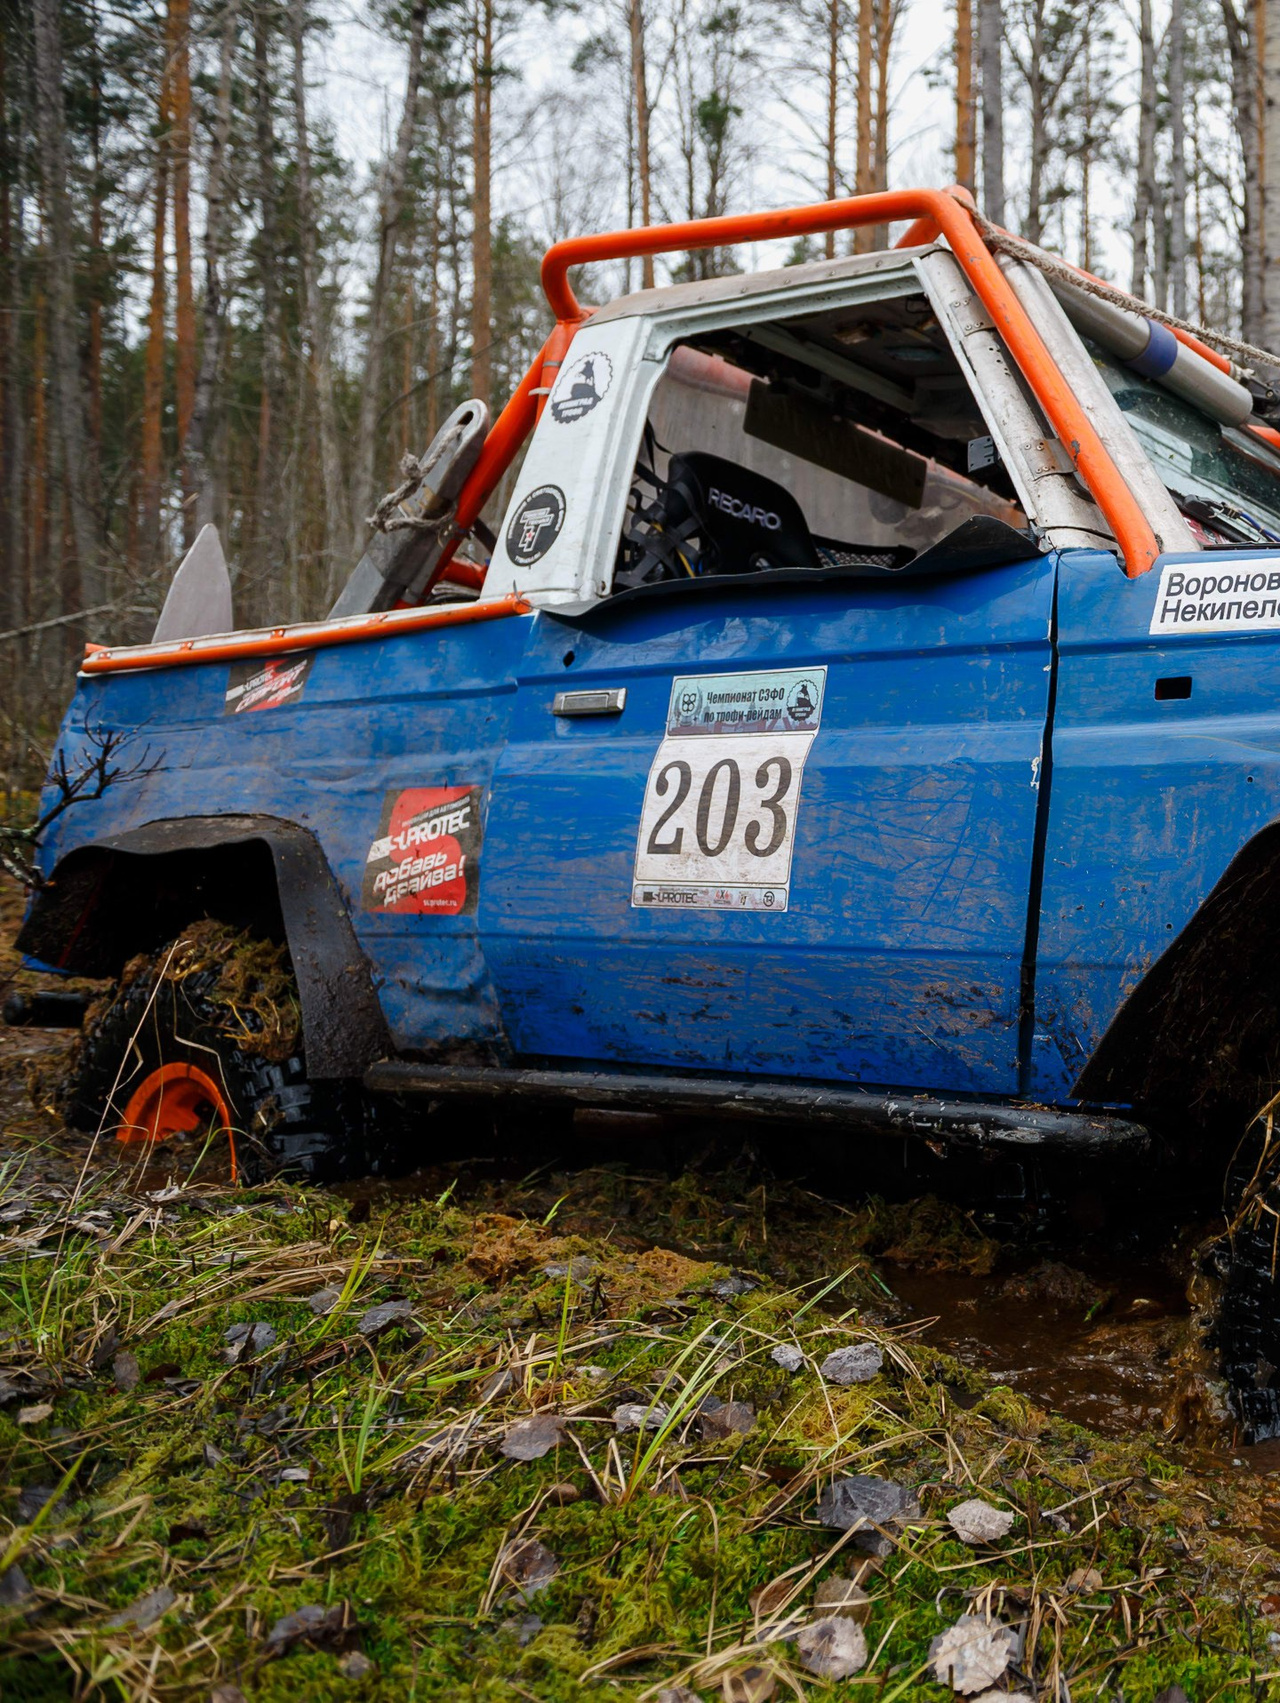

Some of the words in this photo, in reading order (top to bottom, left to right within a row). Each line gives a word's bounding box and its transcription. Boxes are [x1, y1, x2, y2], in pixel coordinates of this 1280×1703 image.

[708, 487, 781, 530] RECARO
[707, 690, 757, 705] Чемпионат
[758, 687, 785, 702] СЗФО
[703, 711, 714, 723] по
[716, 707, 782, 723] трофи-рейдам
[647, 756, 792, 857] 203
[651, 891, 698, 904] SUPROTEC
